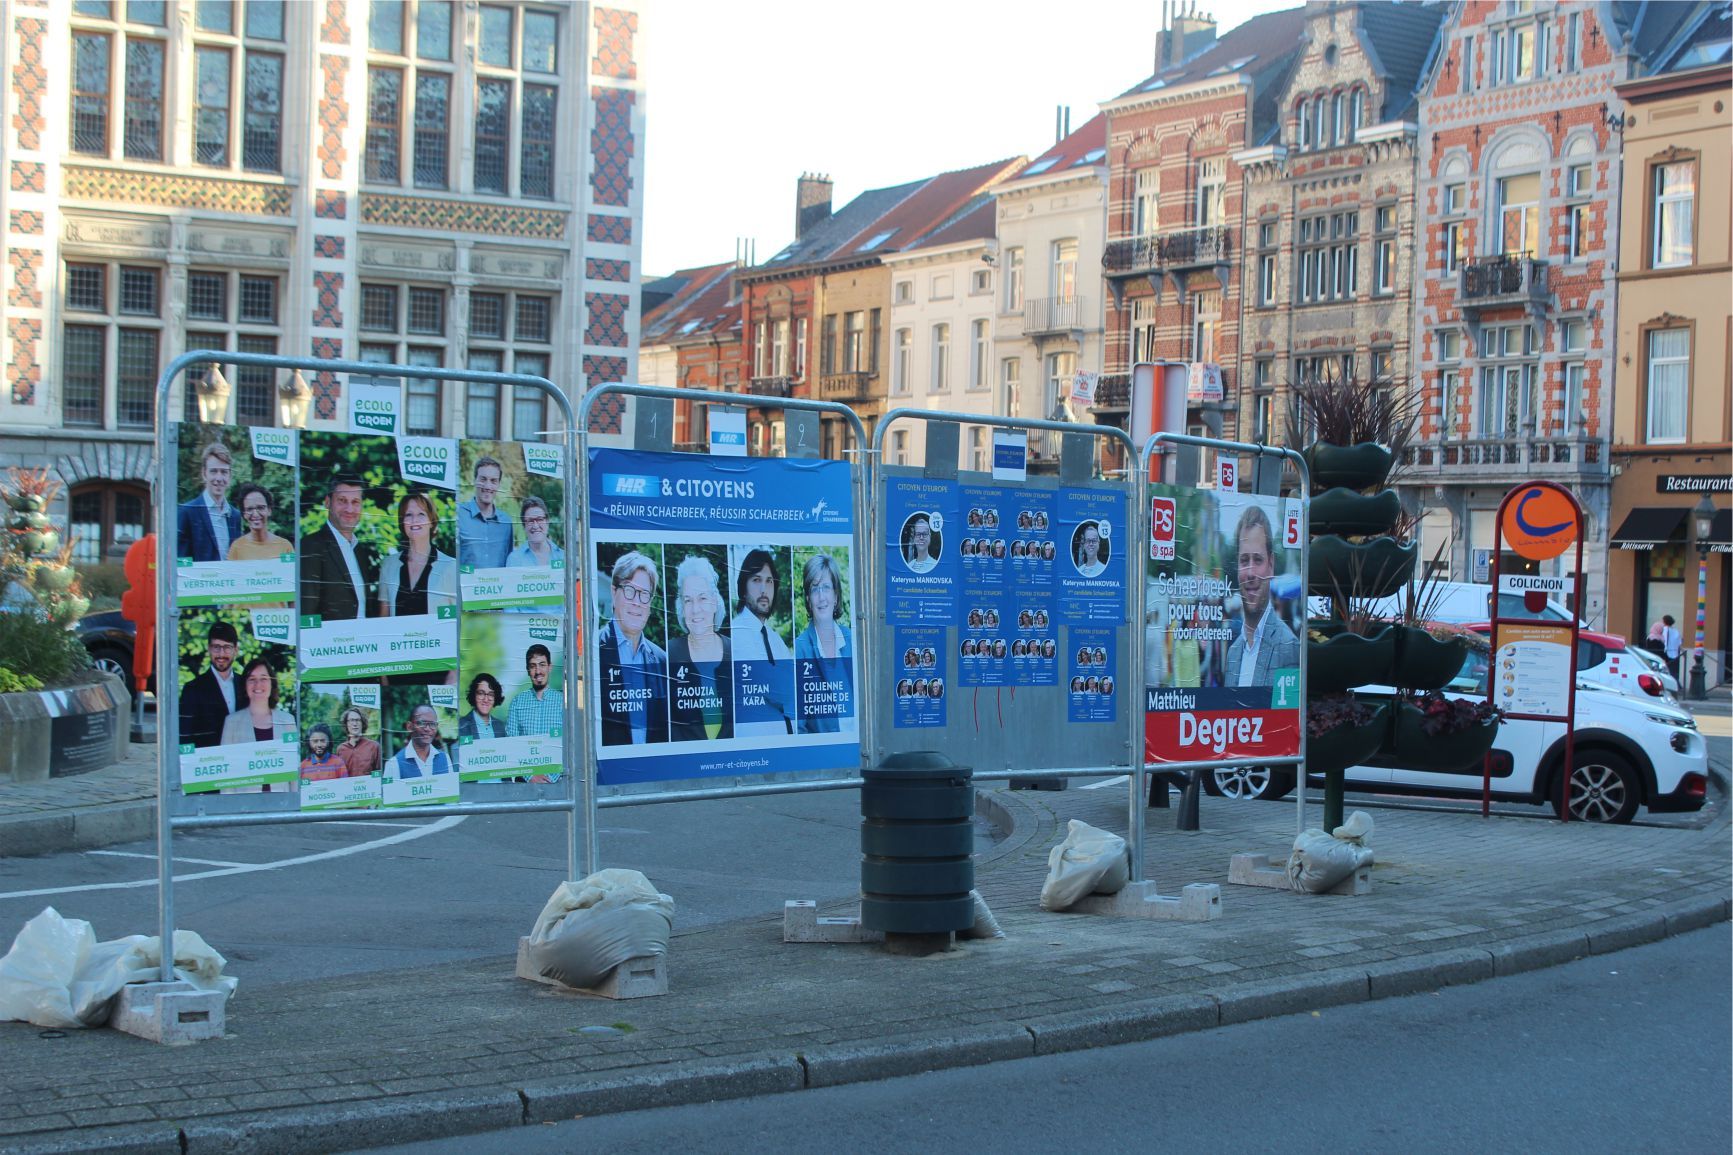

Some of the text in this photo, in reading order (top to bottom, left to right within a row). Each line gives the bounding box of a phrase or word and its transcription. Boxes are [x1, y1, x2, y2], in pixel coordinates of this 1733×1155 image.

[357, 415, 393, 427] GROEN
[718, 433, 737, 443] MR
[258, 446, 287, 456] GROEN
[407, 462, 444, 475] GROEN
[1222, 467, 1233, 482] PS
[615, 477, 755, 499] MR & CITOYENS
[1666, 476, 1732, 491] Restaurant
[610, 501, 645, 517] RÉUNIR
[647, 505, 708, 520] SCHAERBEEK,
[709, 504, 747, 520] RÉUSSIR
[748, 508, 805, 521] SCHAERBEEK
[1287, 509, 1298, 518] LISTE
[932, 520, 940, 529] 13
[1154, 507, 1173, 533] PS
[1287, 518, 1298, 545] 5
[891, 576, 953, 585] Kateryna MANKOVSKA
[1062, 579, 1120, 588] Kateryna MANKOVSKA
[1158, 572, 1233, 598] Schaerbeek
[1509, 577, 1563, 590] COLIGNON
[473, 582, 556, 596] ERALY DECOUX
[443, 607, 451, 618] 2
[1168, 603, 1224, 625] pour tous
[309, 617, 314, 628] 1
[1172, 625, 1233, 641] voor iedereen
[310, 638, 441, 657] VANHALEWYN BYTTEBIER
[676, 665, 689, 680] 4e
[742, 663, 752, 678] 3e
[803, 661, 813, 675] 2e
[608, 667, 621, 682] 1er
[677, 686, 715, 698] FAOUZIA
[742, 683, 770, 694] TUFAN
[803, 681, 844, 692] COLIENNE
[1277, 675, 1296, 706] 1er
[609, 688, 653, 700] GEORGES
[804, 692, 849, 704] LEJEUNE DE
[1148, 689, 1196, 711] Matthieu
[609, 701, 643, 713] VERZIN
[677, 697, 723, 709] CHIADEKH
[743, 696, 766, 706] KARA
[804, 704, 847, 715] SCHIERVEL
[1179, 712, 1263, 754] Degrez
[182, 745, 192, 753] 17
[530, 747, 540, 755] EL
[468, 755, 507, 766] HADDIOUI
[700, 758, 770, 771] www.mr-et-citoyens.be
[194, 757, 285, 777] BAERT BOXUS
[411, 785, 432, 796] BAH
